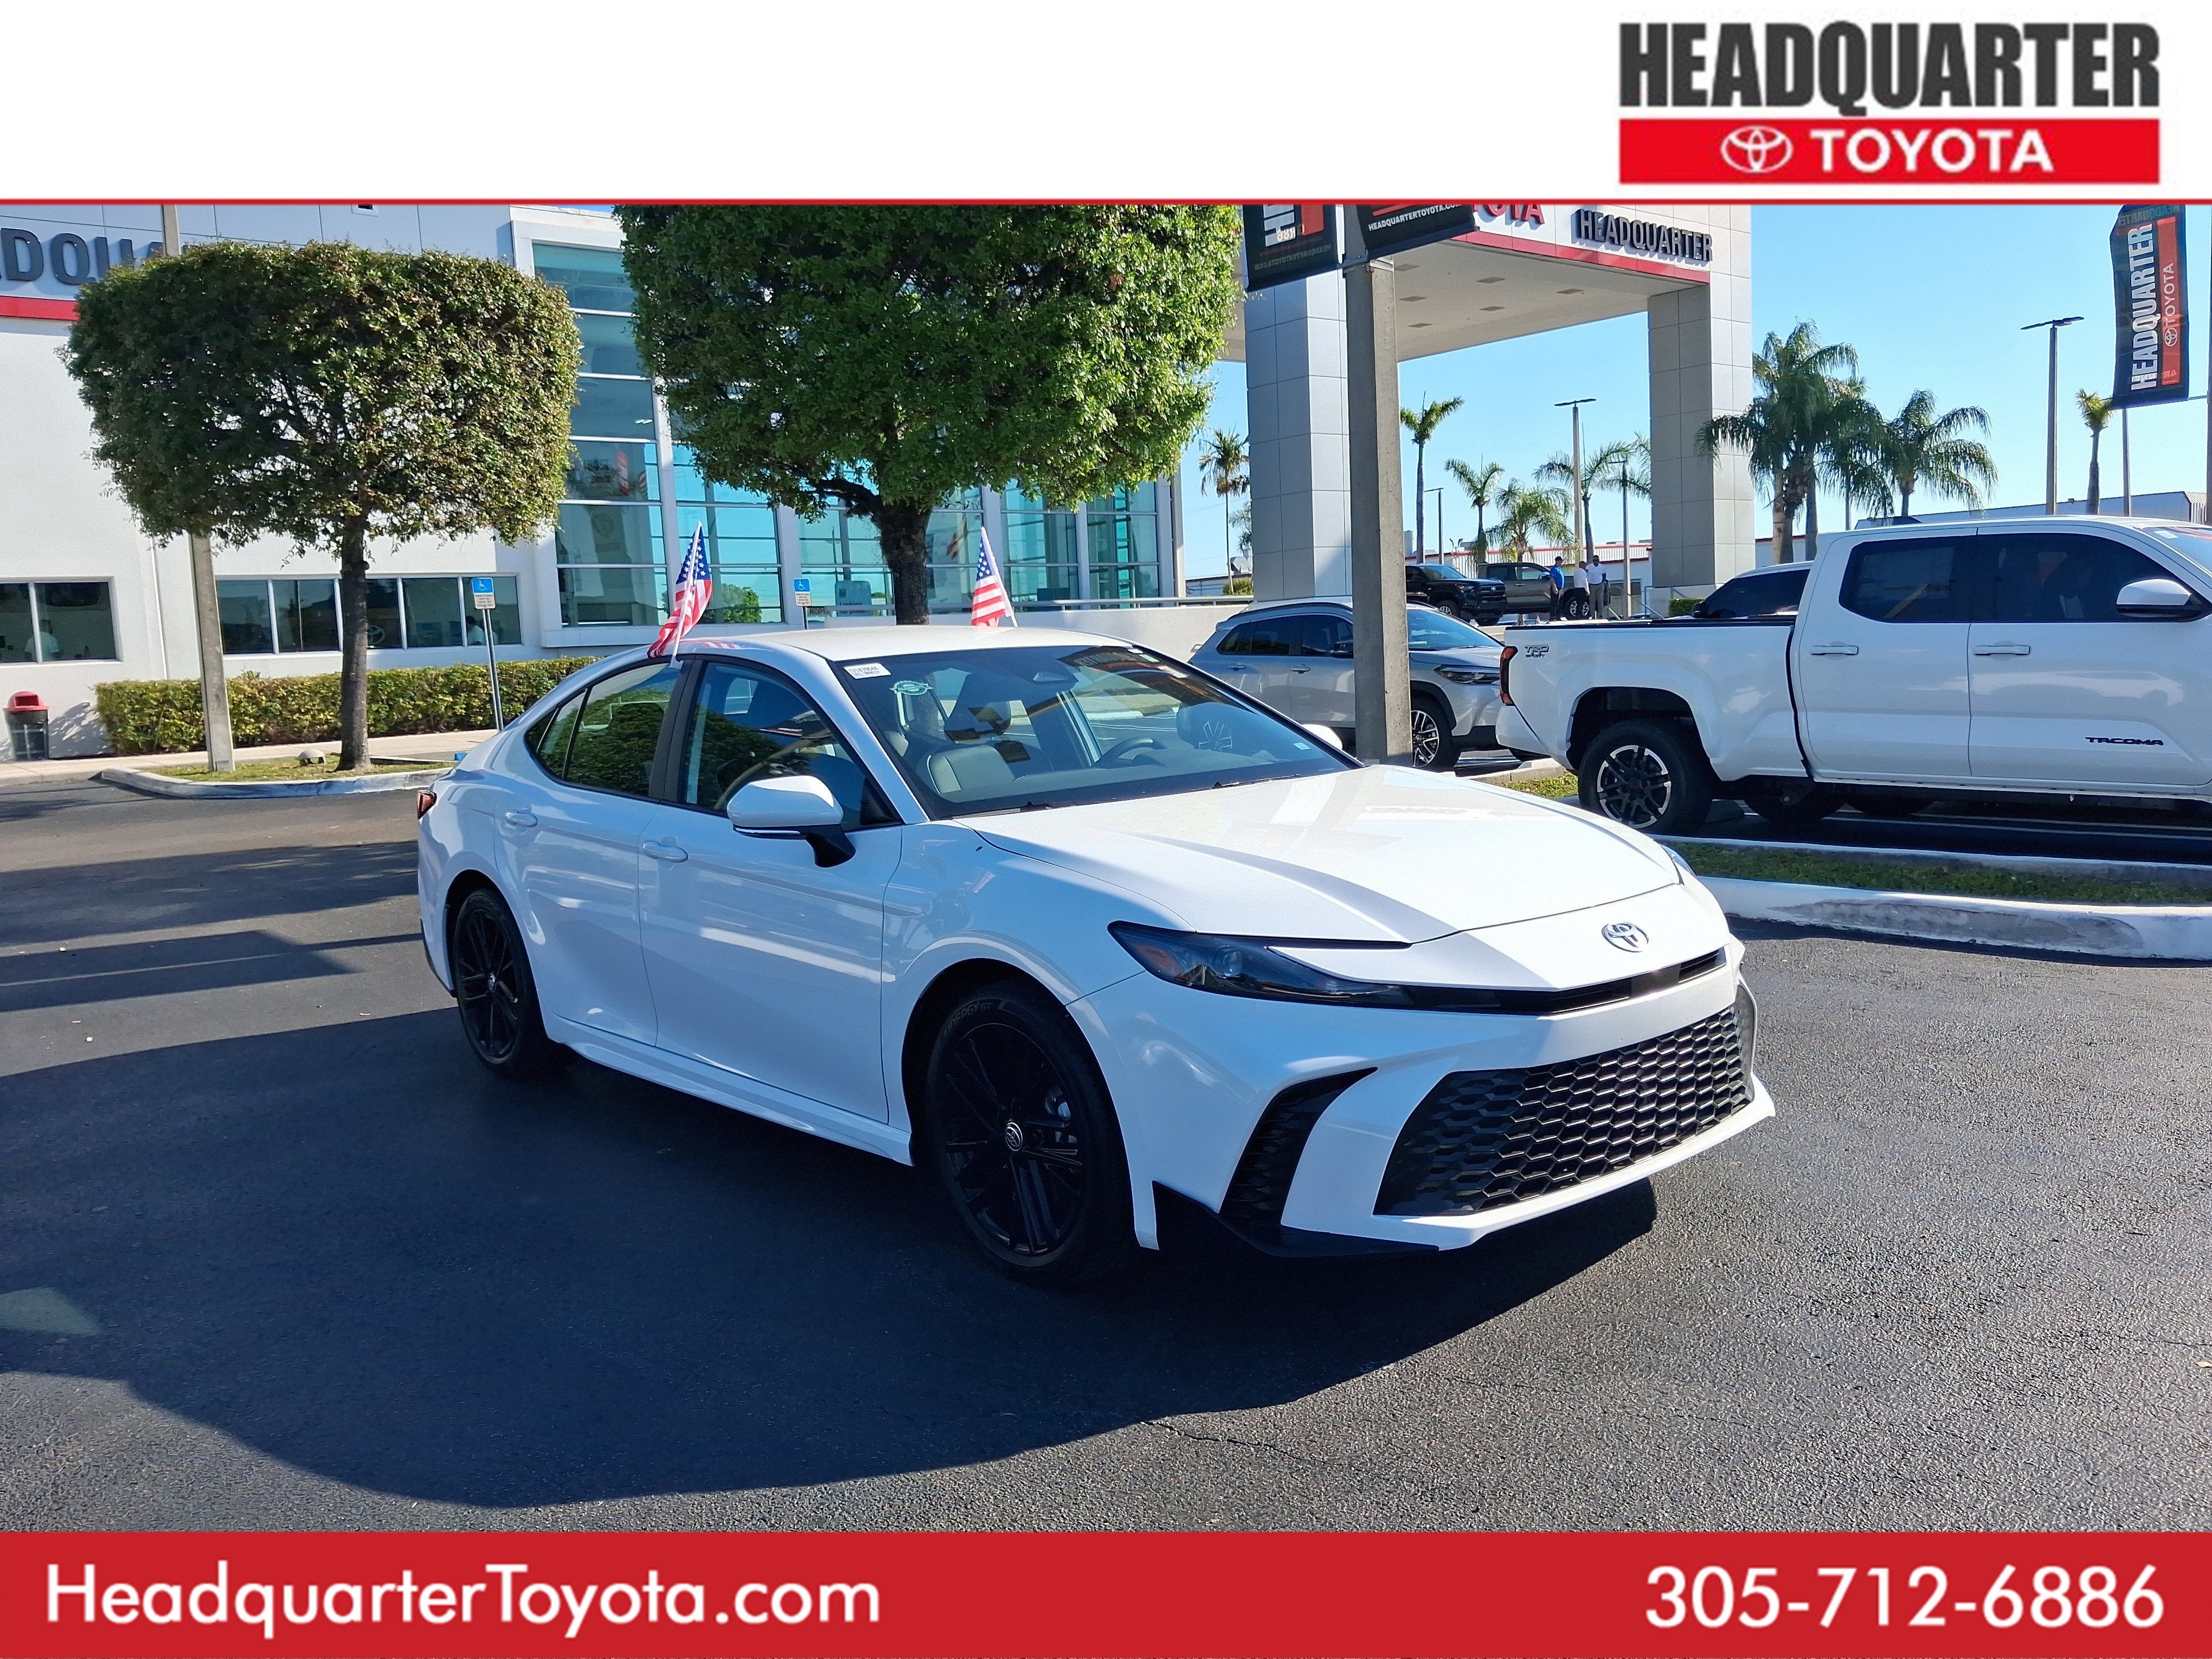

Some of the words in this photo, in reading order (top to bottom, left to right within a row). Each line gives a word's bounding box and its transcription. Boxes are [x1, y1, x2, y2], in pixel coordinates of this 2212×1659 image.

[1575, 209, 1713, 261] HEADQUARTER
[2127, 223, 2160, 390] HEADQUARTER
[2163, 262, 2176, 326] TOYOTA
[1524, 645, 1549, 655] TRD
[2085, 737, 2164, 746] TACOMA
